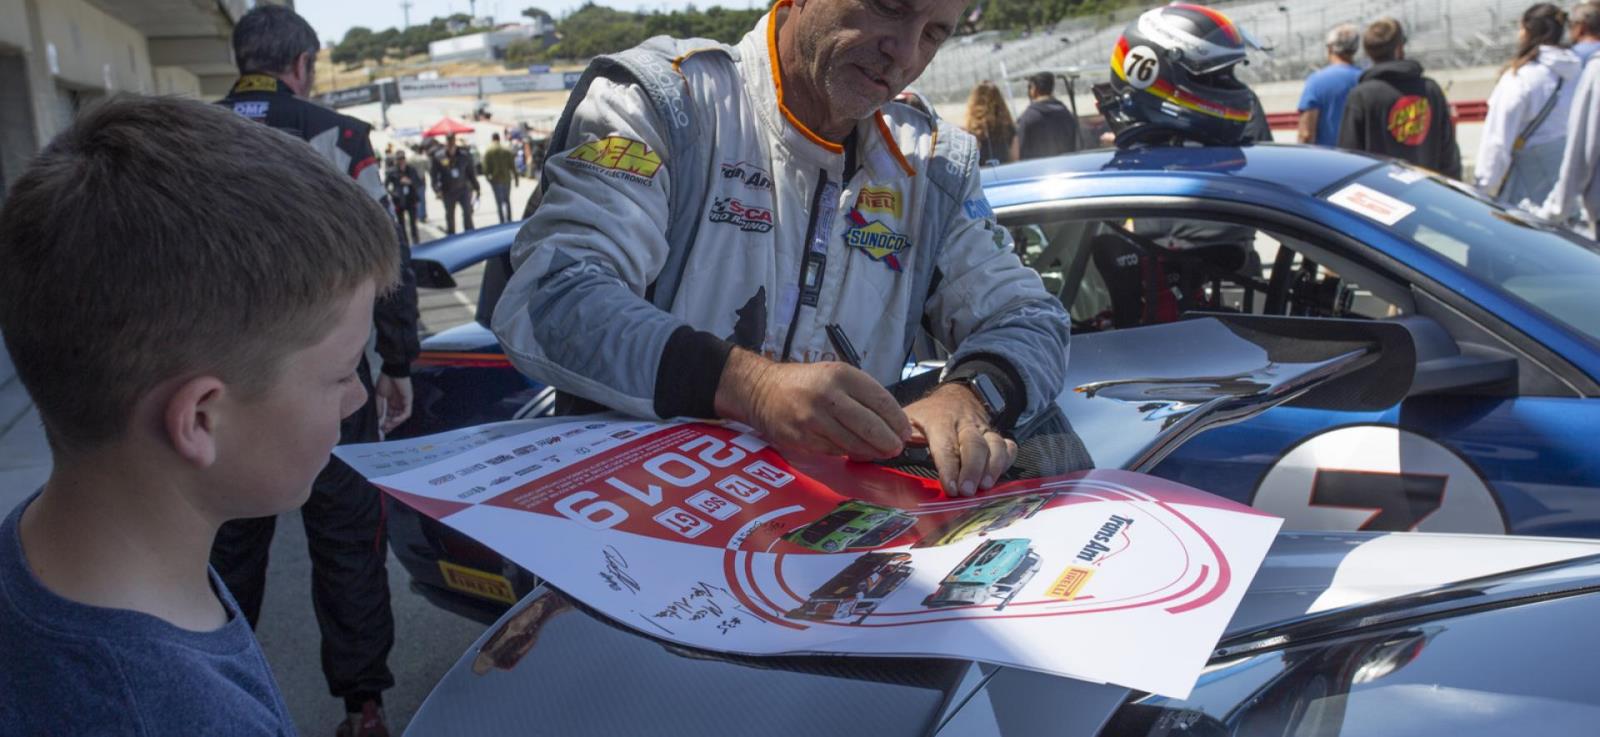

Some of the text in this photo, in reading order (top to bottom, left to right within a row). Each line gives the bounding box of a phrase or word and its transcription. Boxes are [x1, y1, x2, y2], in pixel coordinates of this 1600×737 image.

[1126, 54, 1157, 82] 76
[566, 136, 663, 179] AEM
[729, 200, 773, 224] SCA
[731, 214, 770, 231] RING
[849, 229, 904, 252] SUNOCO
[554, 434, 746, 530] 2019
[751, 466, 786, 482] TA
[725, 480, 761, 497] T2
[699, 496, 727, 513] SGT
[669, 512, 702, 533] GT
[1076, 513, 1134, 561] Trans Am
[1051, 567, 1089, 597] PIRELLI
